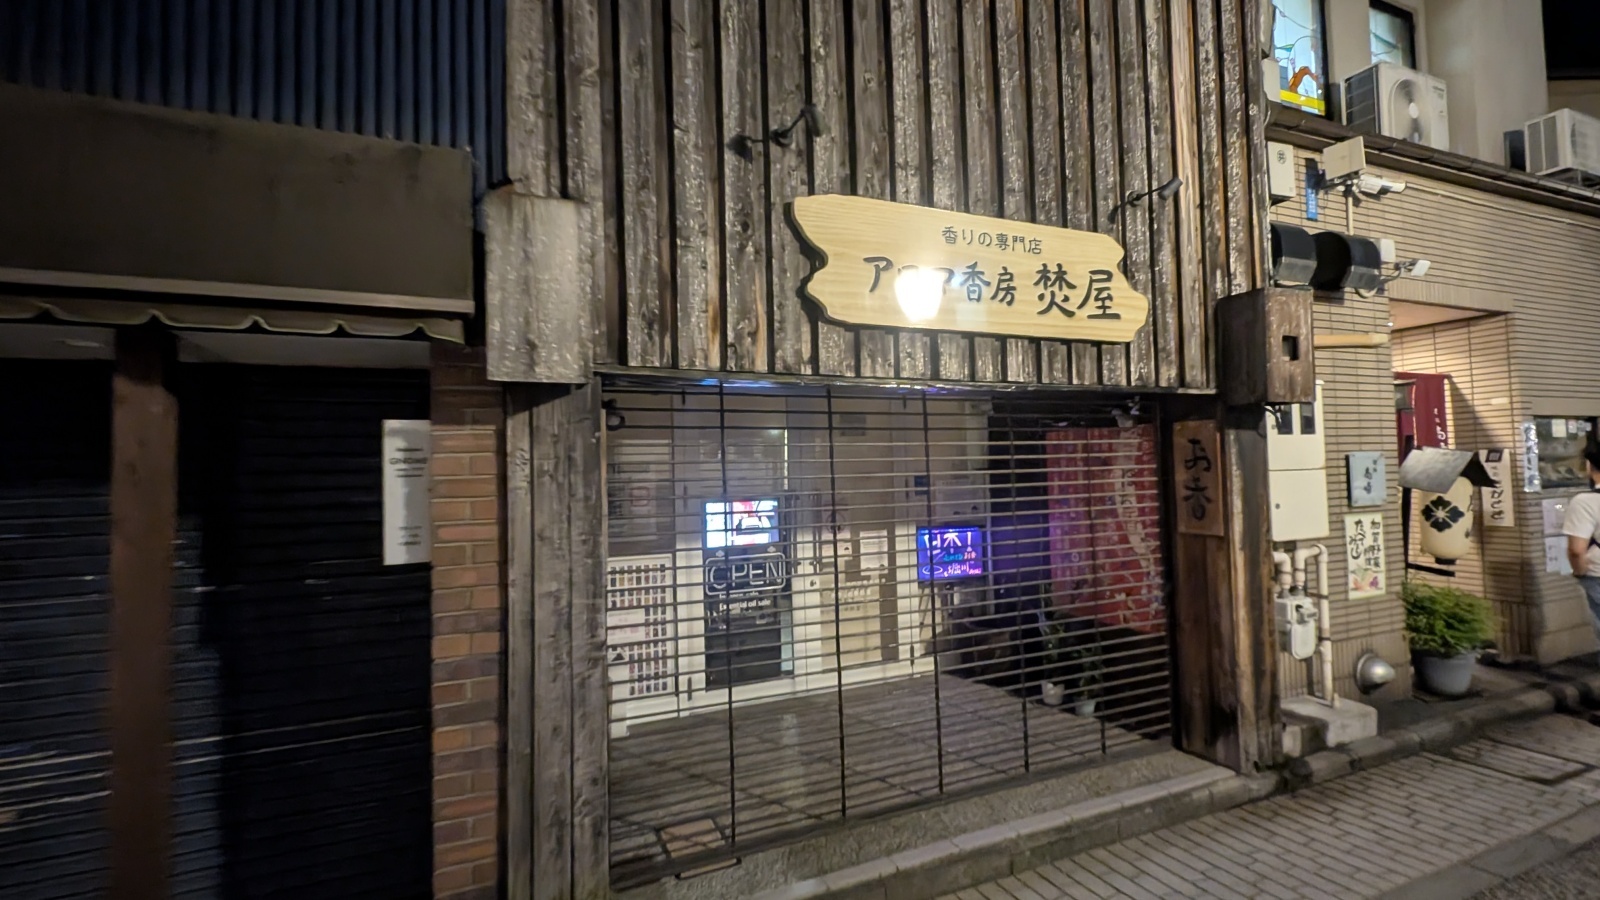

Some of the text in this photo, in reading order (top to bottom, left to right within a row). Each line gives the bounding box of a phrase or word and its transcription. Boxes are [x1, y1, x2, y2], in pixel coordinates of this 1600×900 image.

[941, 226, 1042, 255] 香りの専門店
[863, 256, 1123, 321] ア香房 焚屋
[709, 560, 783, 590] OPEN
[719, 601, 748, 610] Esential
